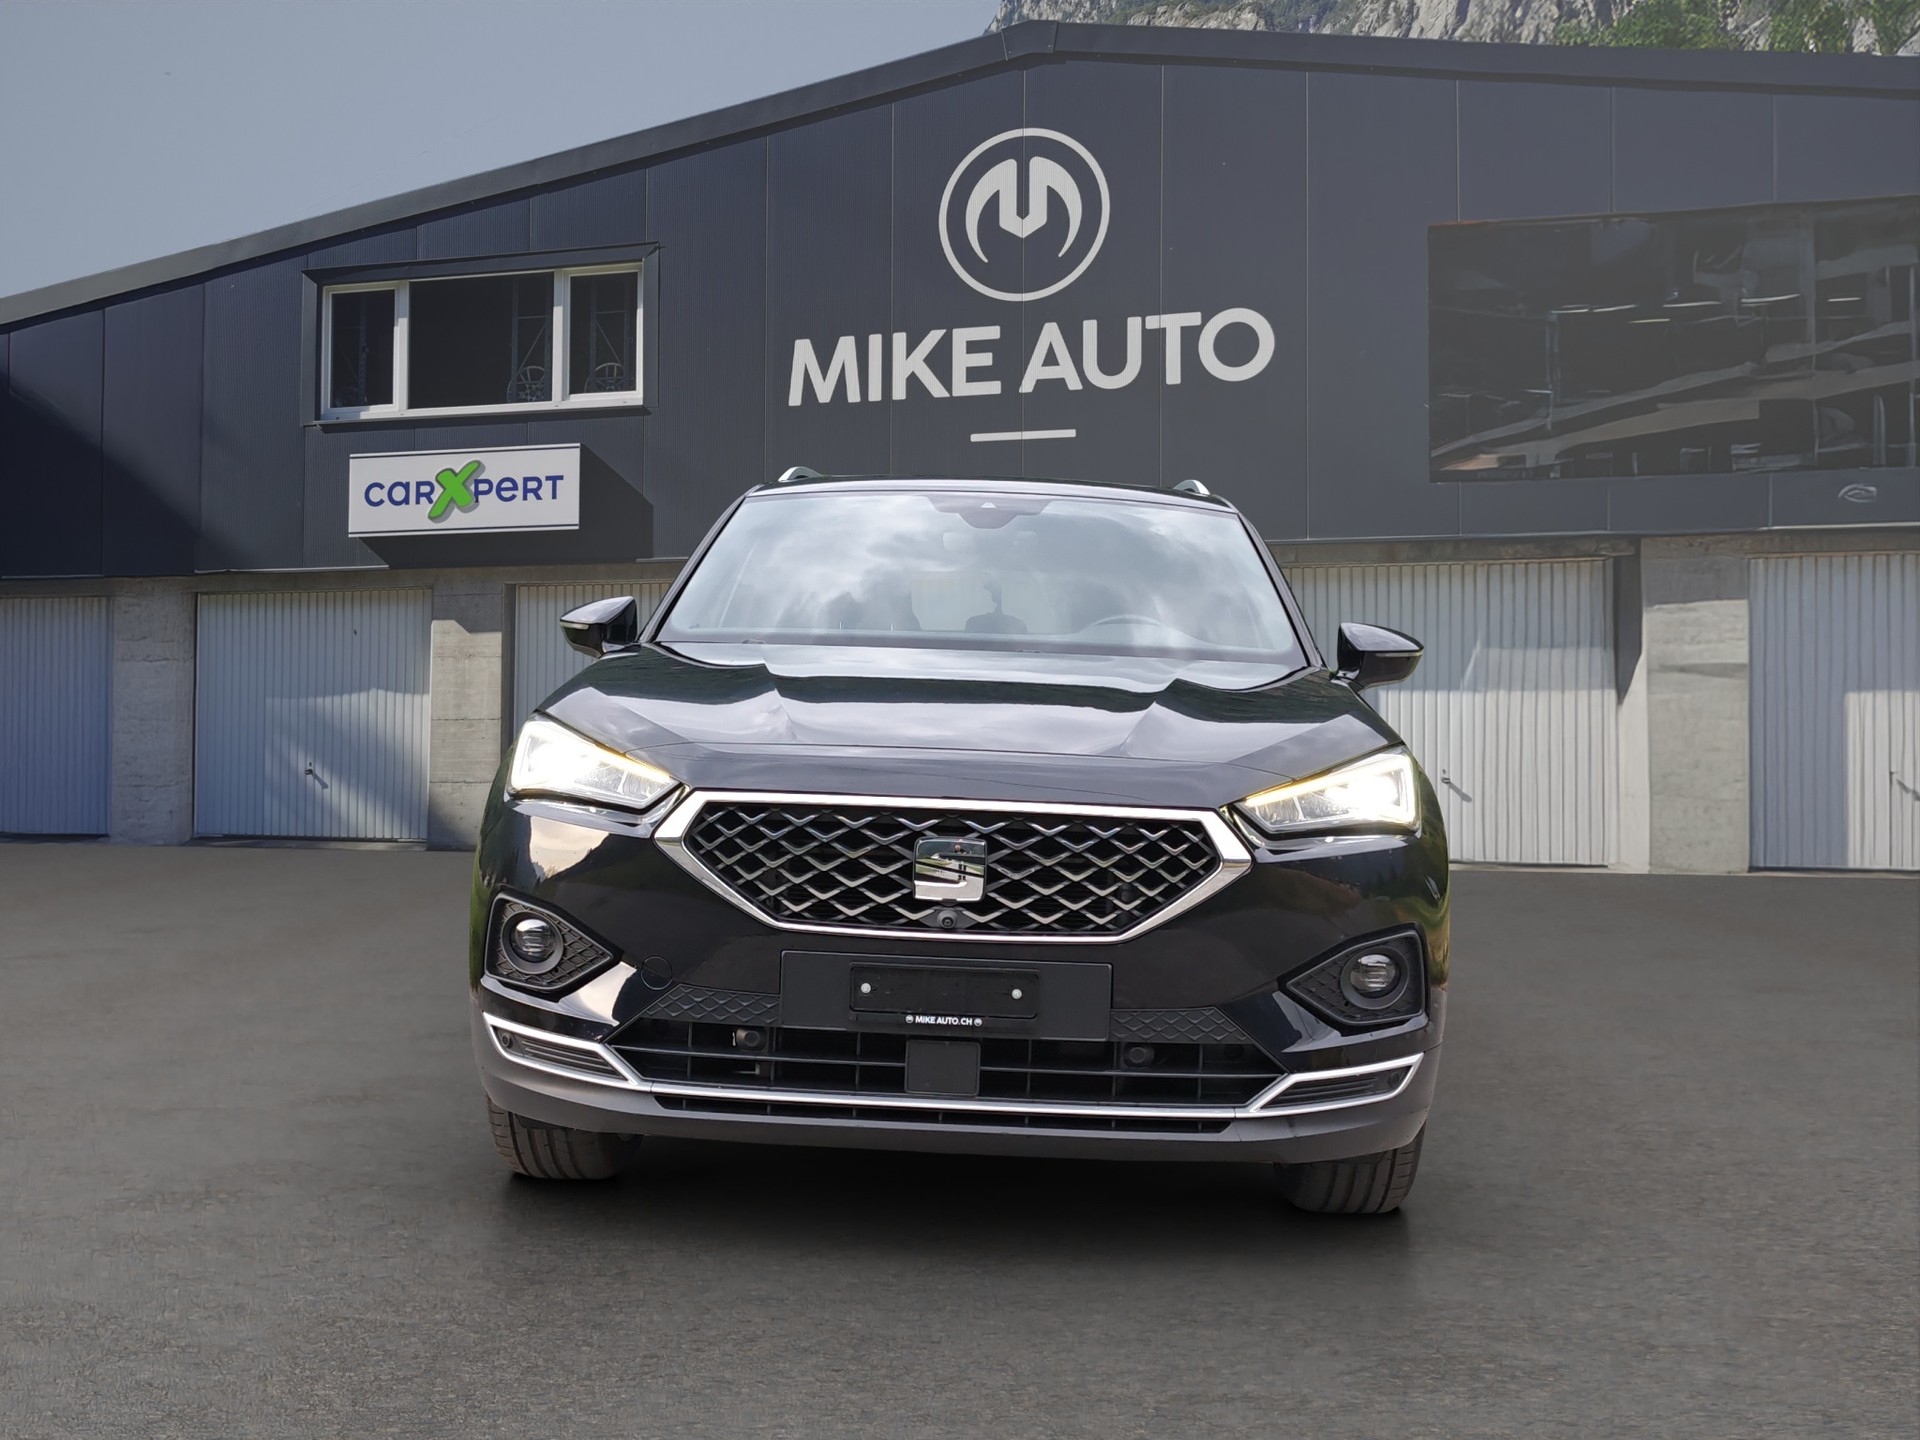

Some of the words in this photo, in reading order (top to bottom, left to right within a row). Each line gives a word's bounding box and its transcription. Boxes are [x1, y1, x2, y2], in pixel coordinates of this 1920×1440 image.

[788, 325, 1001, 407] MIKE
[1018, 307, 1276, 394] AUTO
[915, 1015, 936, 1025] MIKE
[936, 1016, 973, 1026] AUTO.CH
